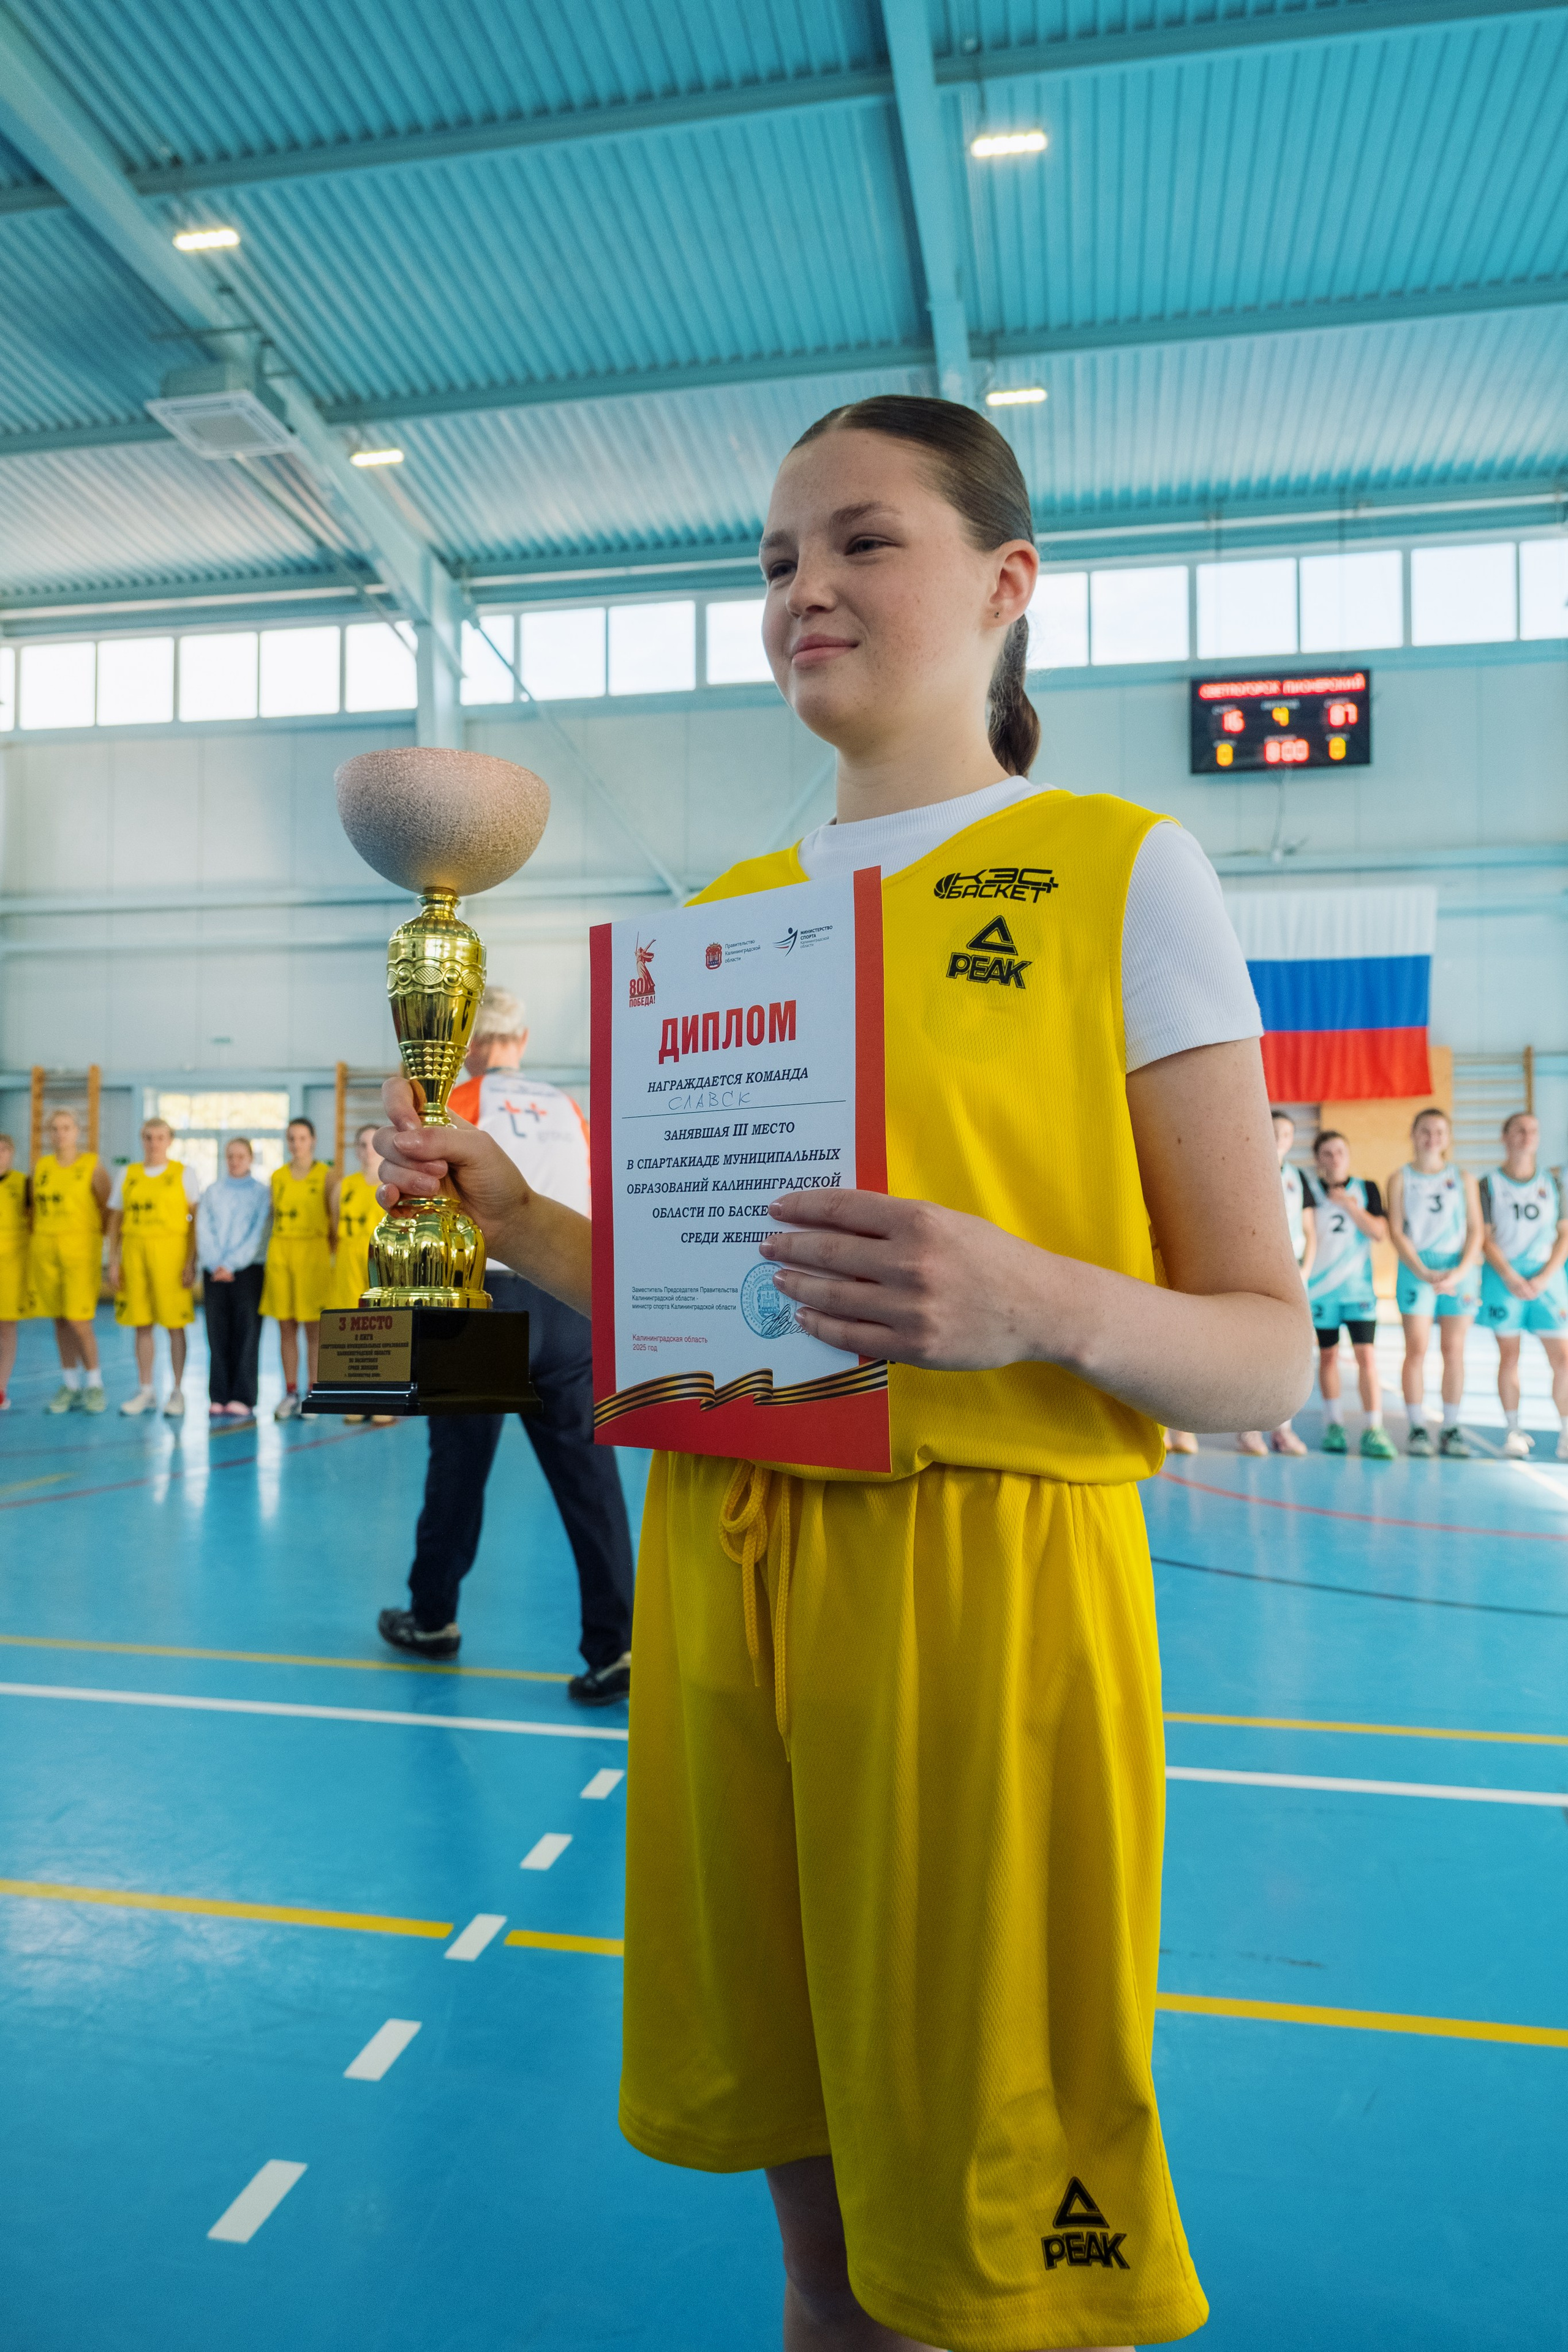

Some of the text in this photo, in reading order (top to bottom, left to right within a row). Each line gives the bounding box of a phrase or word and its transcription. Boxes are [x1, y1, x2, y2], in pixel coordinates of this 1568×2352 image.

[945, 883, 1046, 903] БАСКЕТ
[800, 925, 833, 935] МИНИСТЕРСТВО
[725, 939, 755, 949] Правительство
[725, 945, 761, 956] Калининградской
[946, 952, 1033, 989] PEAK
[629, 977, 644, 996] 80
[629, 995, 655, 1008] ПОБЕДА!
[658, 1000, 796, 1065] ДИПЛОМ
[647, 1068, 809, 1093] НАГРАЖДАЕТСЯ КОМАНДА
[668, 1091, 751, 1110] СЛАВСК
[663, 1121, 795, 1141] ЗАНЯВШАЯ III МЕСТО
[627, 1148, 841, 1170] В СПАРТАКИАДЕ МУНИЦИПАЛЬНЫХ
[627, 1172, 842, 1194] ОБРАЗОВАНИЙ КАЛИНИНГРАДСКОЙ
[652, 1204, 769, 1218] ОБЛАСТИ ПО БАСКЕ
[1429, 1194, 1443, 1213] 3
[1512, 1203, 1540, 1221] 10
[1330, 1215, 1344, 1232] 2
[681, 1232, 719, 1245] СРЕДИ
[339, 1315, 393, 1331] 3 МЕСТО
[632, 1334, 683, 1343] Калининградская
[1041, 2231, 1131, 2271] PEAK
